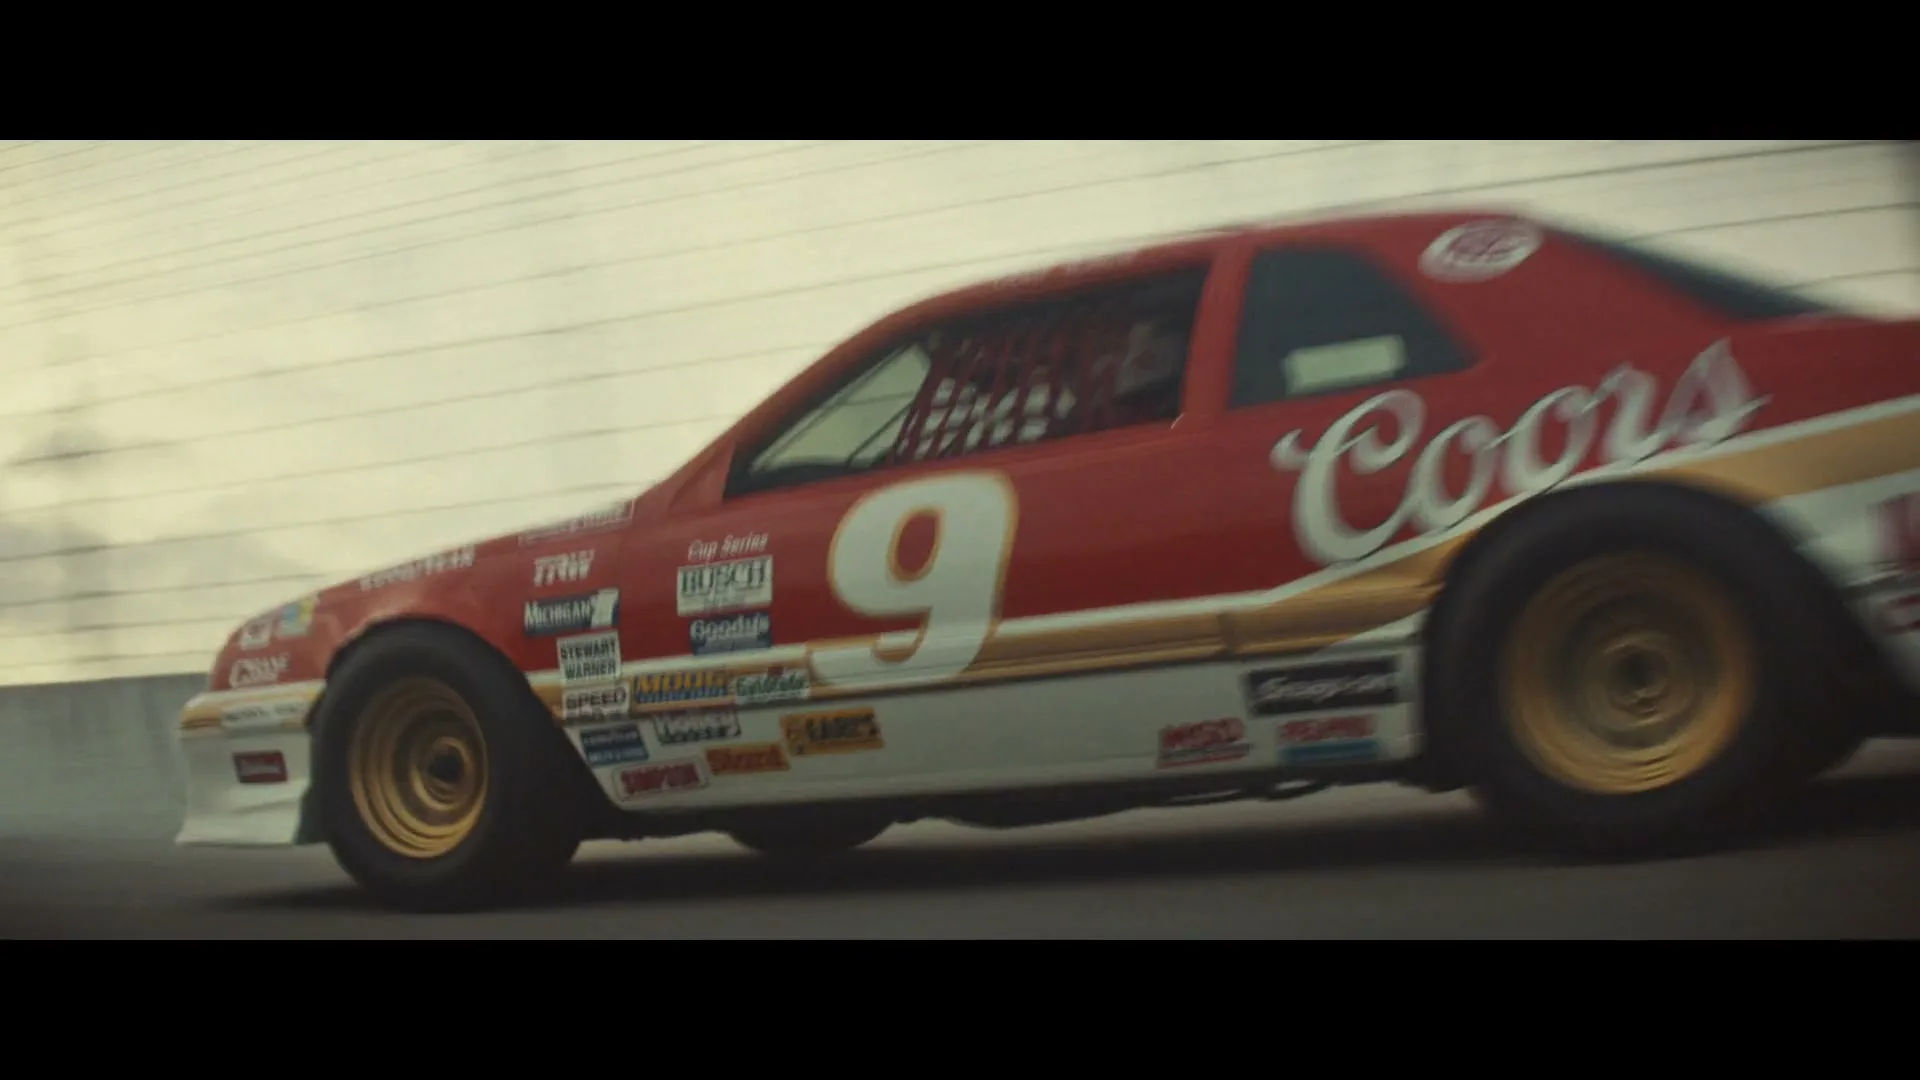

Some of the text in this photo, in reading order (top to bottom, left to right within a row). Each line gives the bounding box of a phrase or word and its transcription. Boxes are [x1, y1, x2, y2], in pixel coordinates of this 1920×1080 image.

[1269, 338, 1771, 568] Coors
[688, 531, 769, 564] Cup Series
[680, 559, 767, 597] BUSCH
[808, 468, 1018, 686] 9
[560, 638, 617, 662] STEWART
[563, 657, 617, 681] WARNER
[565, 685, 627, 709] SPEED
